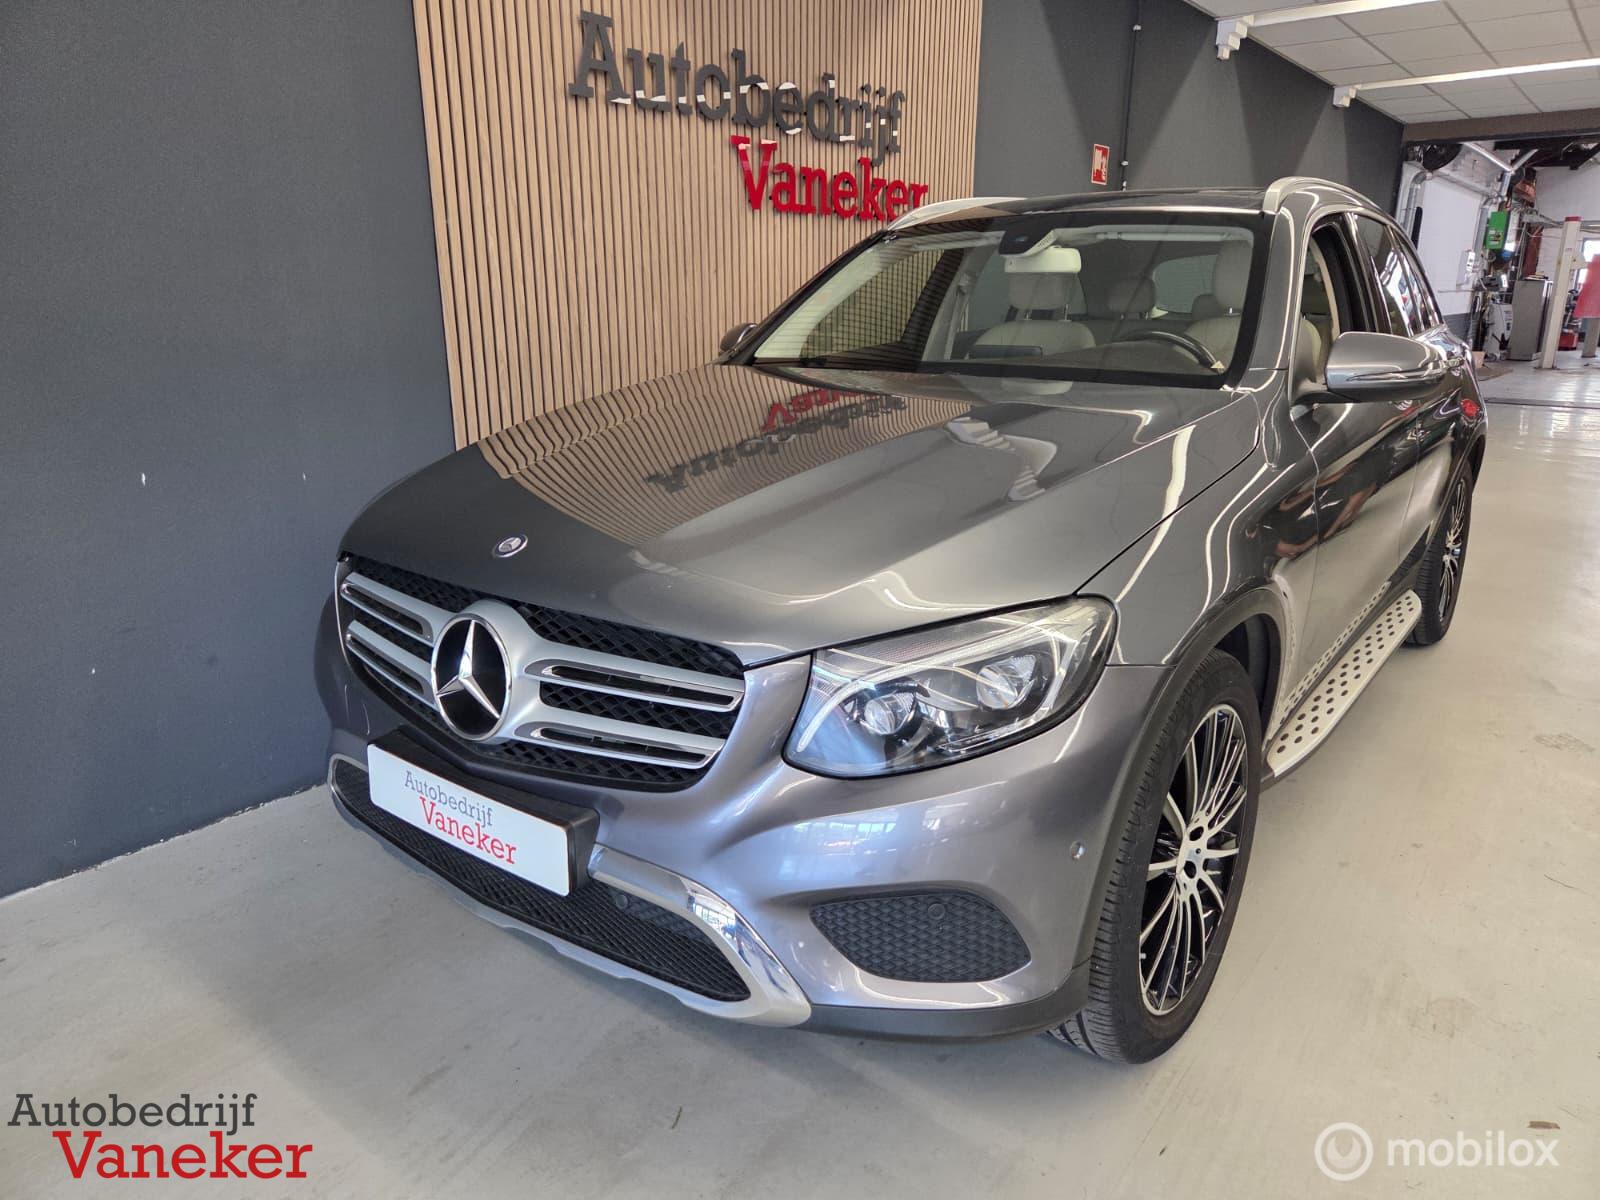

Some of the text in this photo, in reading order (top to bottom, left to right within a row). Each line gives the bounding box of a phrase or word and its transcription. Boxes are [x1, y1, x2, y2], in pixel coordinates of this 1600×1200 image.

[567, 10, 906, 167] Autobedrijf
[731, 135, 929, 221] Vaneker
[404, 770, 494, 827] Autobedrijf
[420, 797, 517, 864] Vaneker
